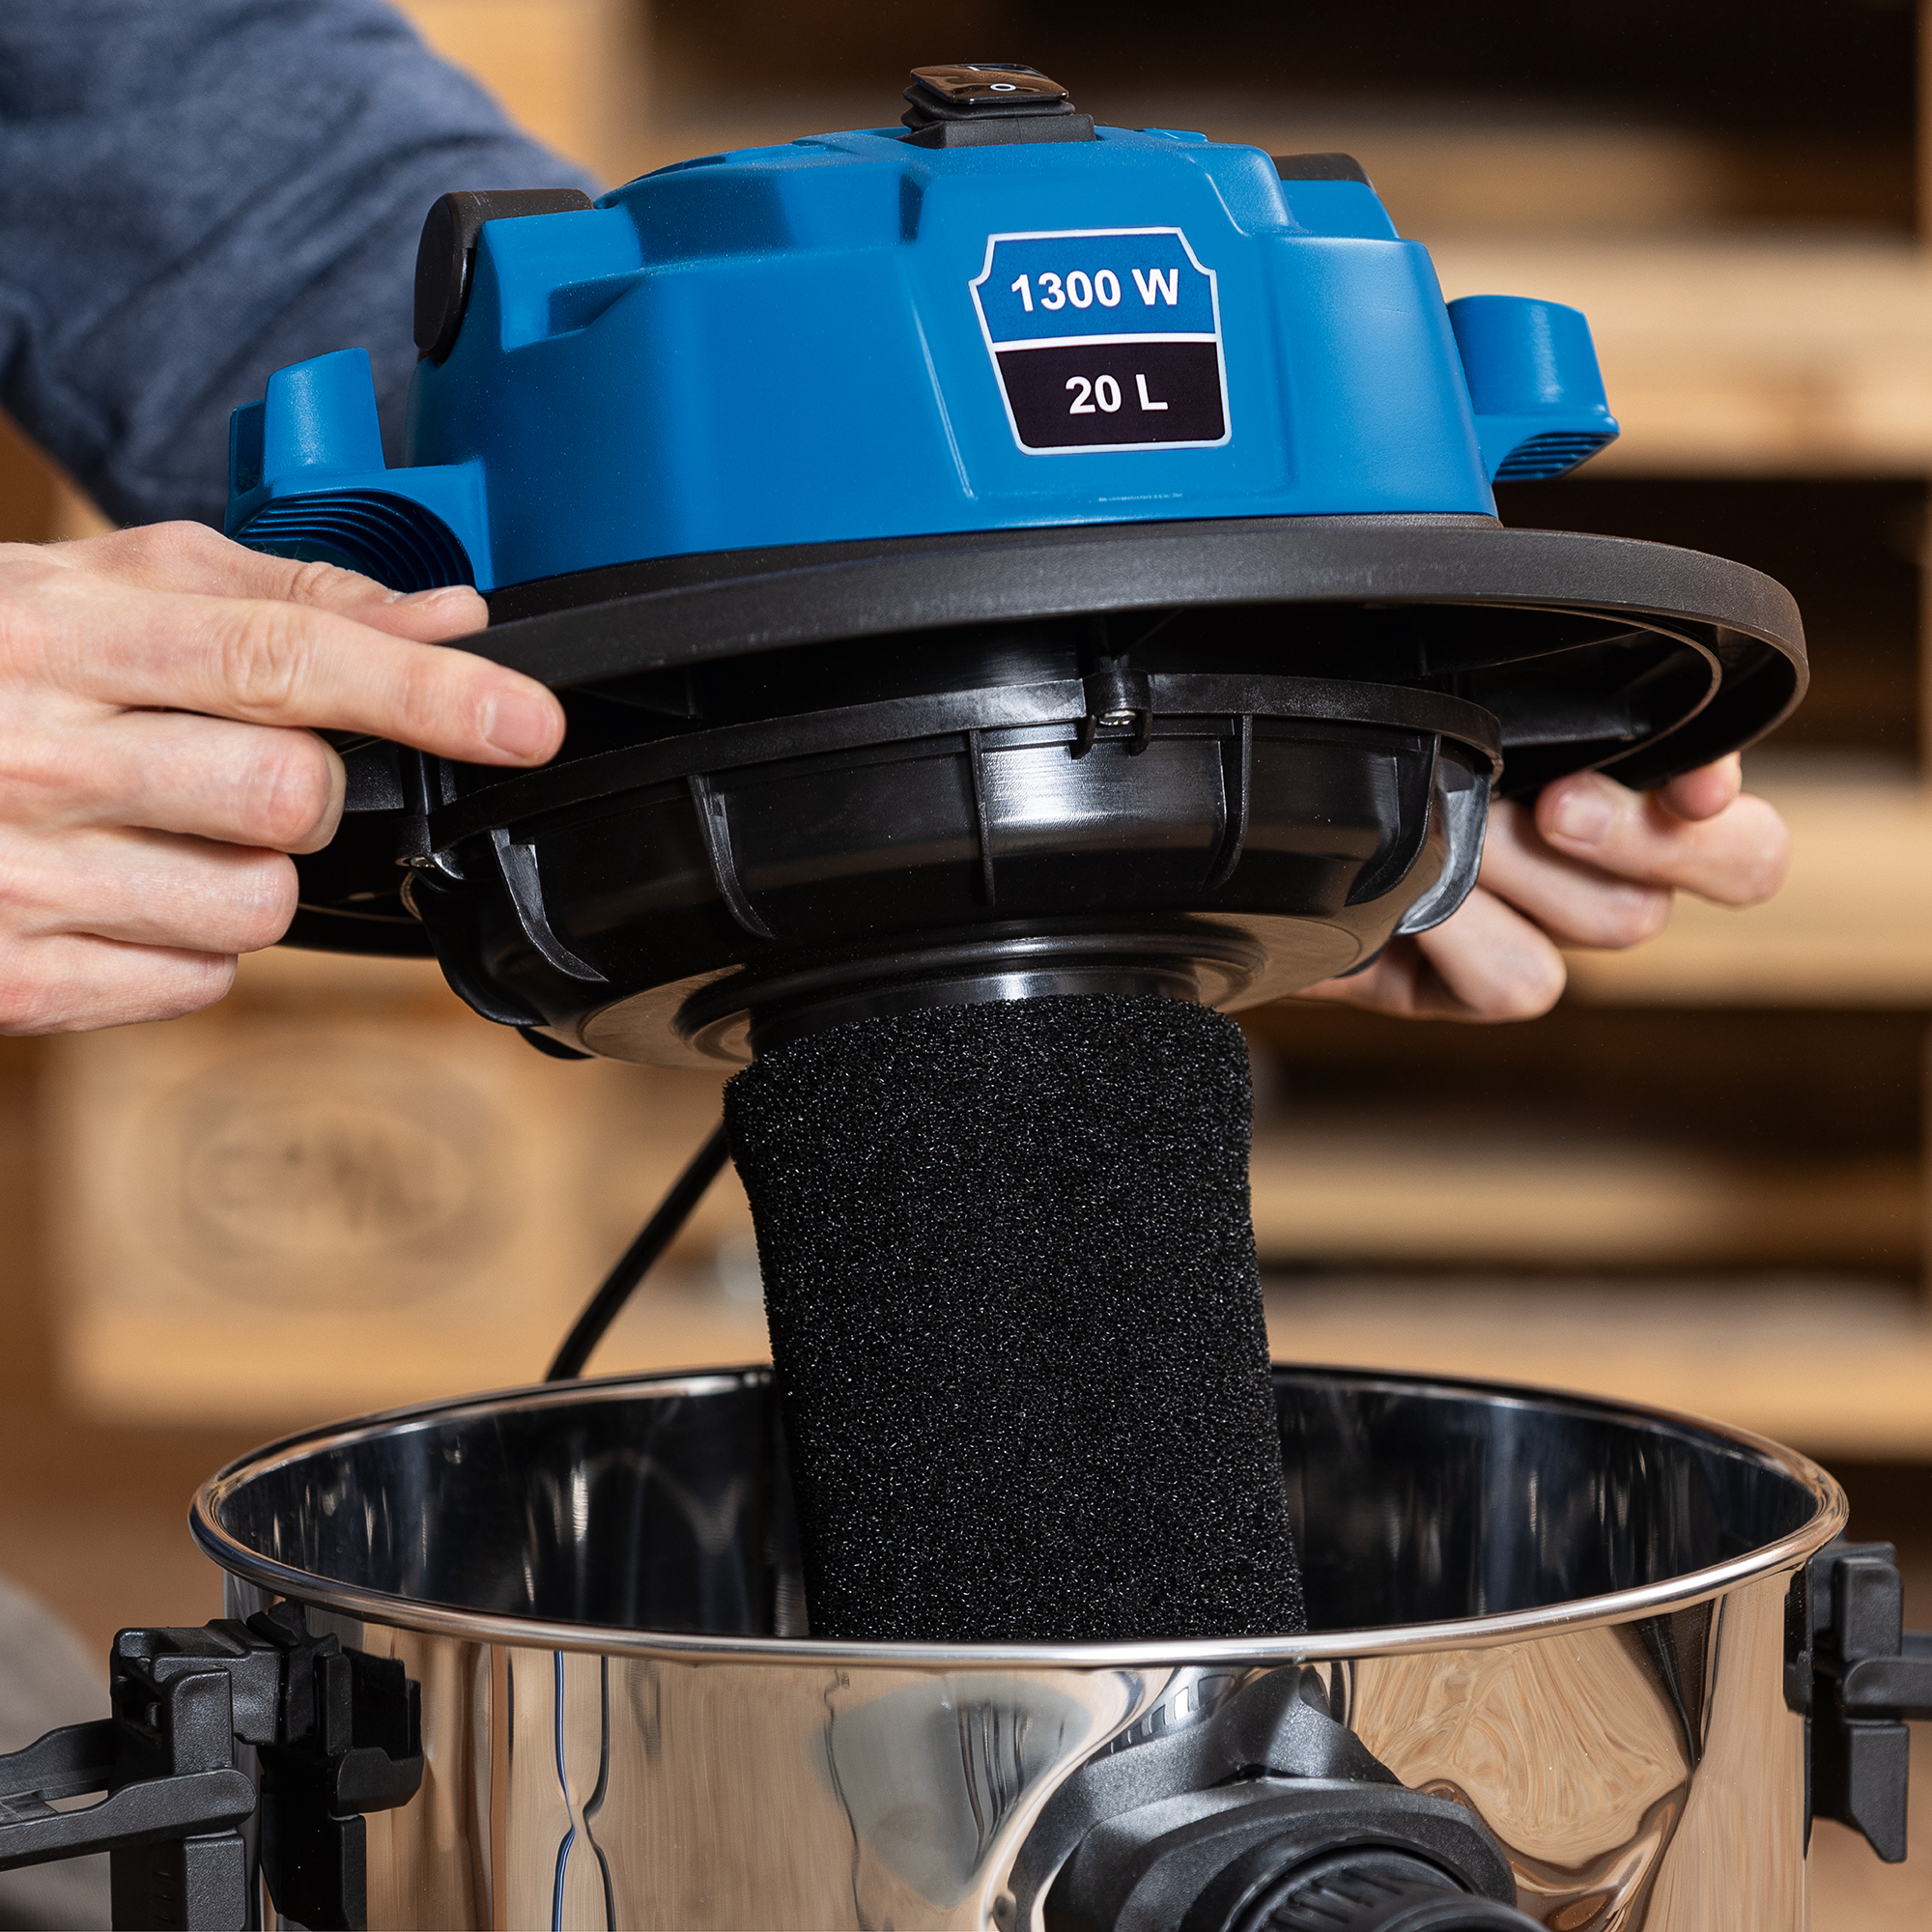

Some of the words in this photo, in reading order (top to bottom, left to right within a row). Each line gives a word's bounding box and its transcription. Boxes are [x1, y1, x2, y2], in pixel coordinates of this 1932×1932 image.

[1010, 270, 1122, 312] 1300
[1131, 268, 1179, 306] W
[1065, 374, 1122, 414] 20
[1135, 374, 1169, 411] L
